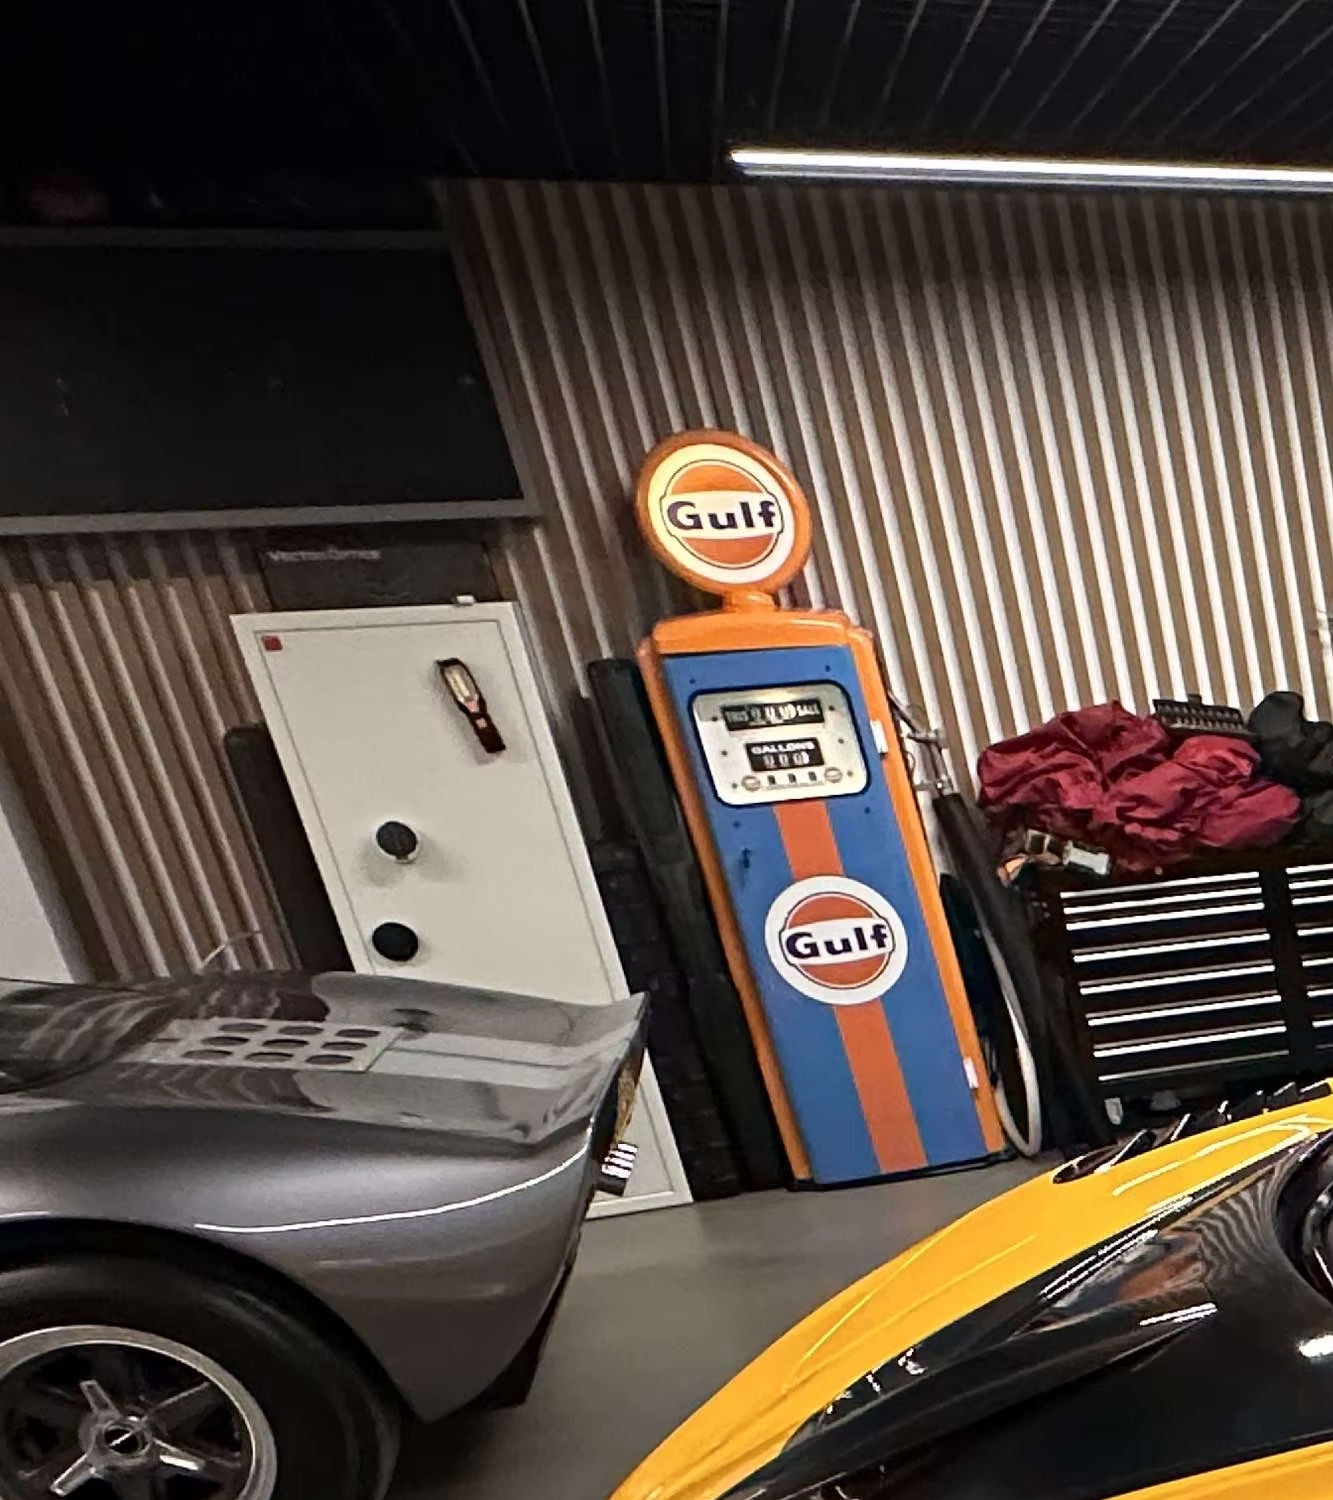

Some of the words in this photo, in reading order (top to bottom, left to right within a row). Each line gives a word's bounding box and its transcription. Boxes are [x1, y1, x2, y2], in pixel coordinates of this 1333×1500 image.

[667, 500, 776, 530] Gulf
[751, 742, 816, 754] GALLONS
[785, 923, 888, 959] Gulf
